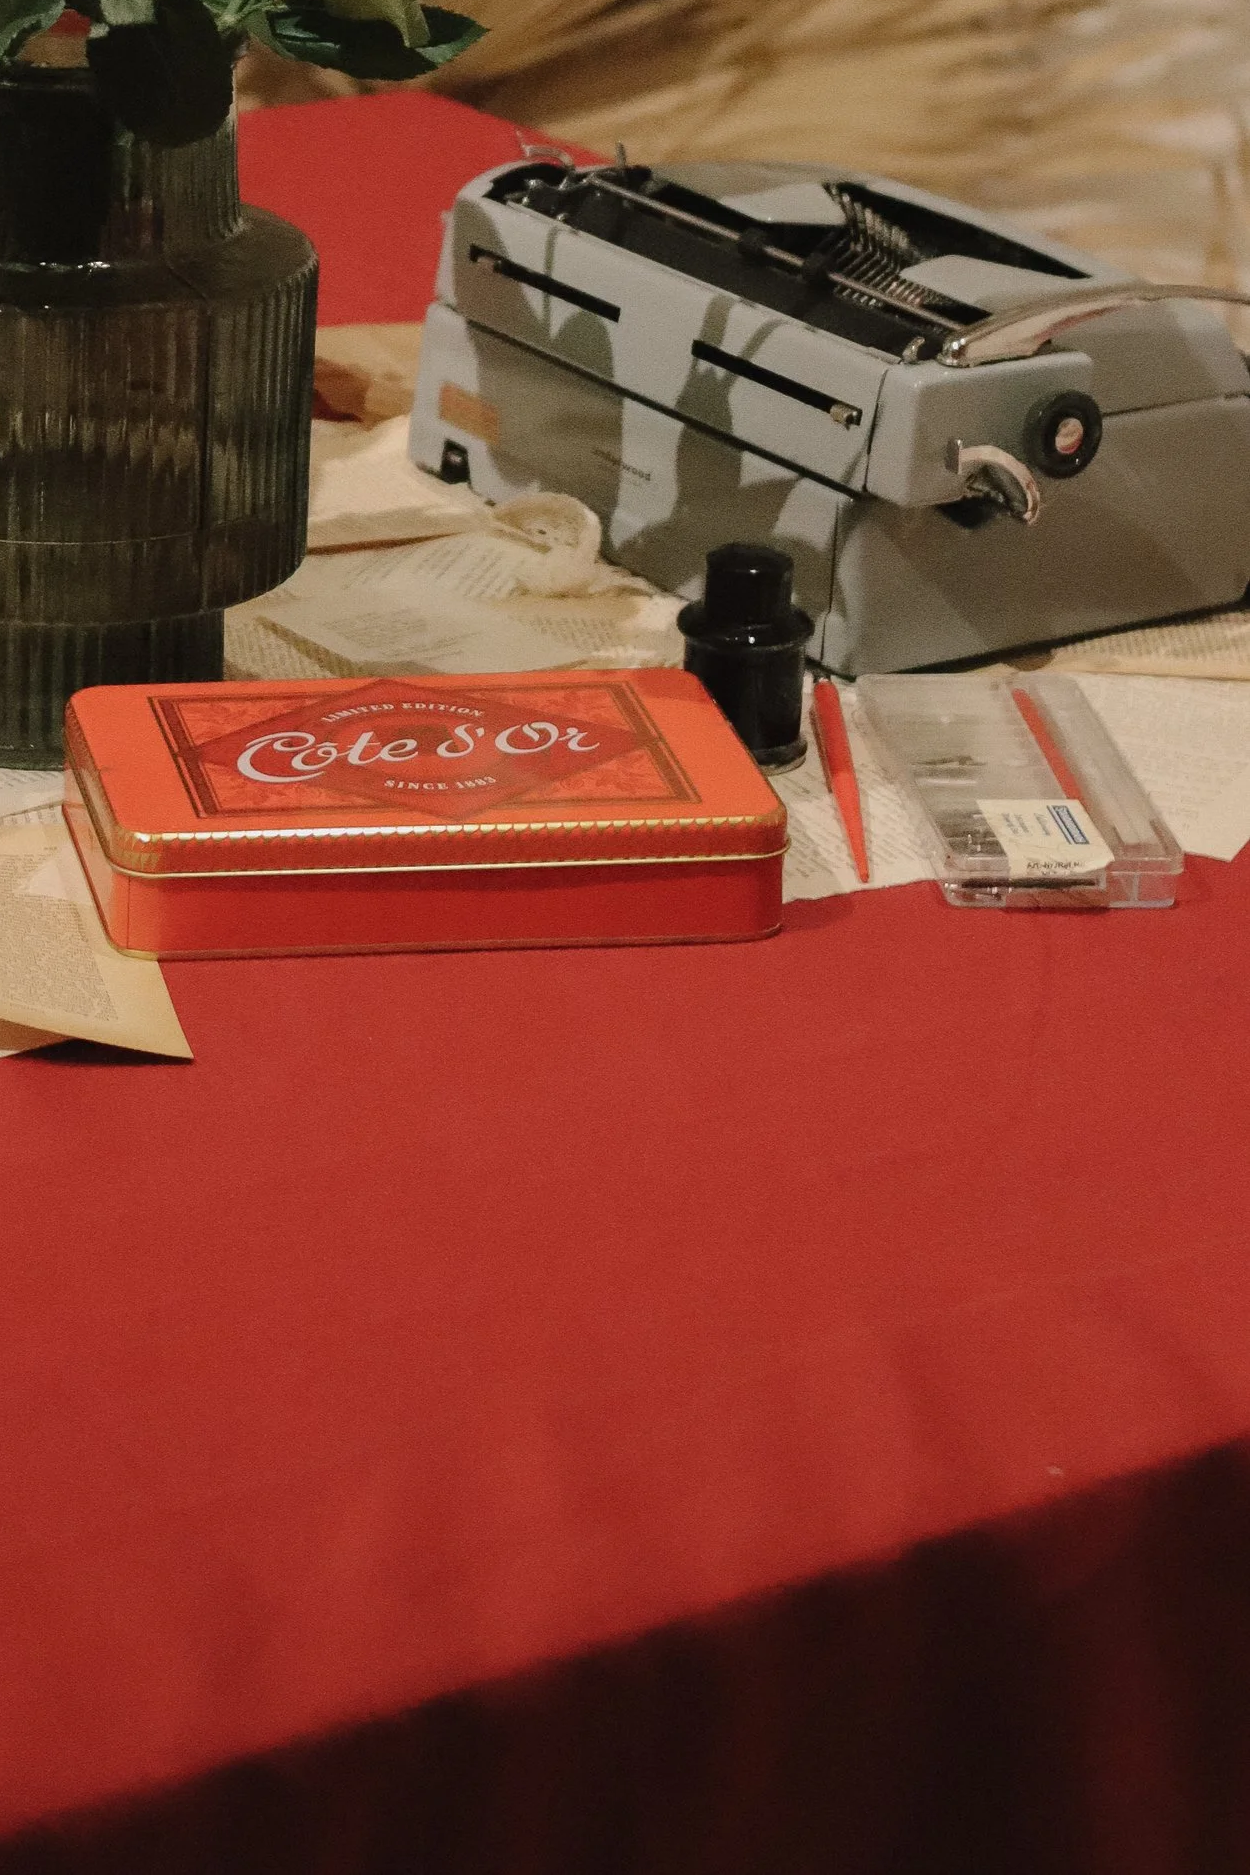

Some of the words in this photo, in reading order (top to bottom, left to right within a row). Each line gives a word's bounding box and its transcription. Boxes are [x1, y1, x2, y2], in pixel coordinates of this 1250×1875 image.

[321, 703, 395, 723] LIMITED
[401, 702, 485, 717] EDITION
[236, 730, 419, 784] Côte
[384, 778, 449, 791] SINCE
